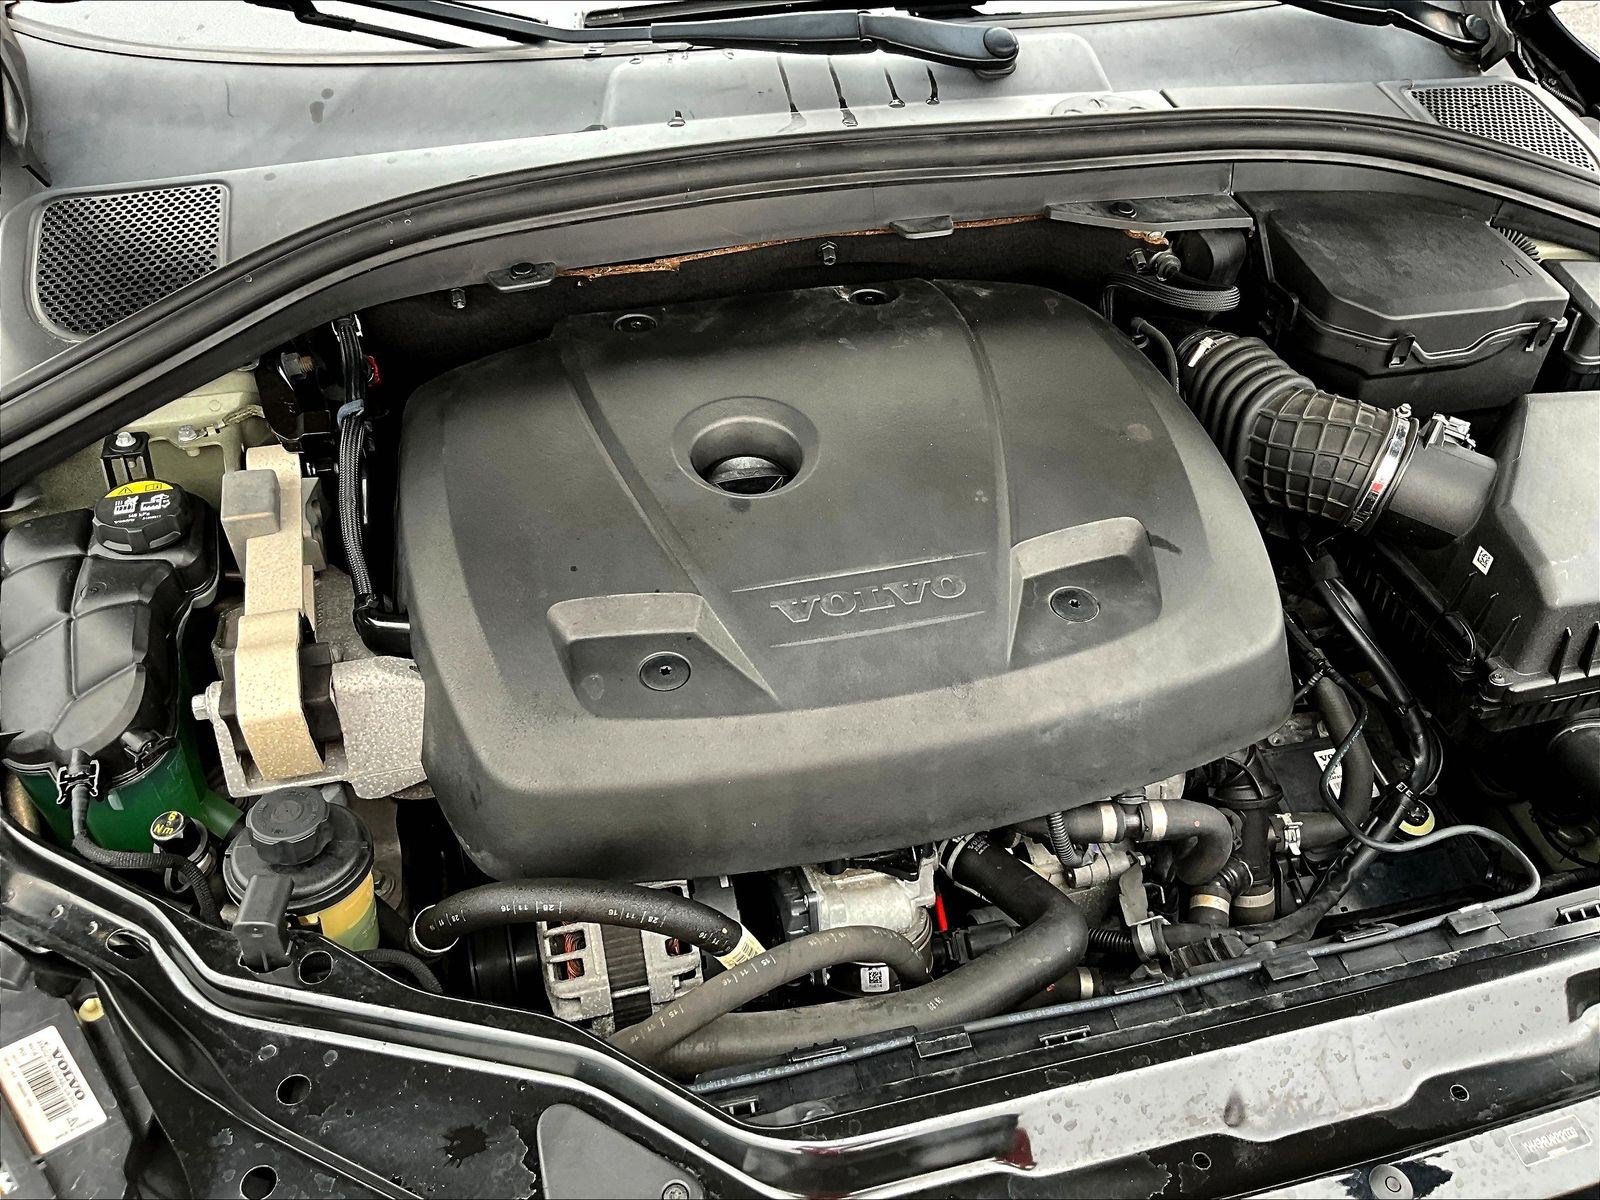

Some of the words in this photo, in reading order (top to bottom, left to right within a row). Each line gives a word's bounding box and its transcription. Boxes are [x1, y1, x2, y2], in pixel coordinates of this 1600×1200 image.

[770, 574, 966, 622] VOLVO
[153, 823, 174, 835] Nm
[168, 811, 178, 821] 6
[52, 1046, 85, 1101] VOLVO
